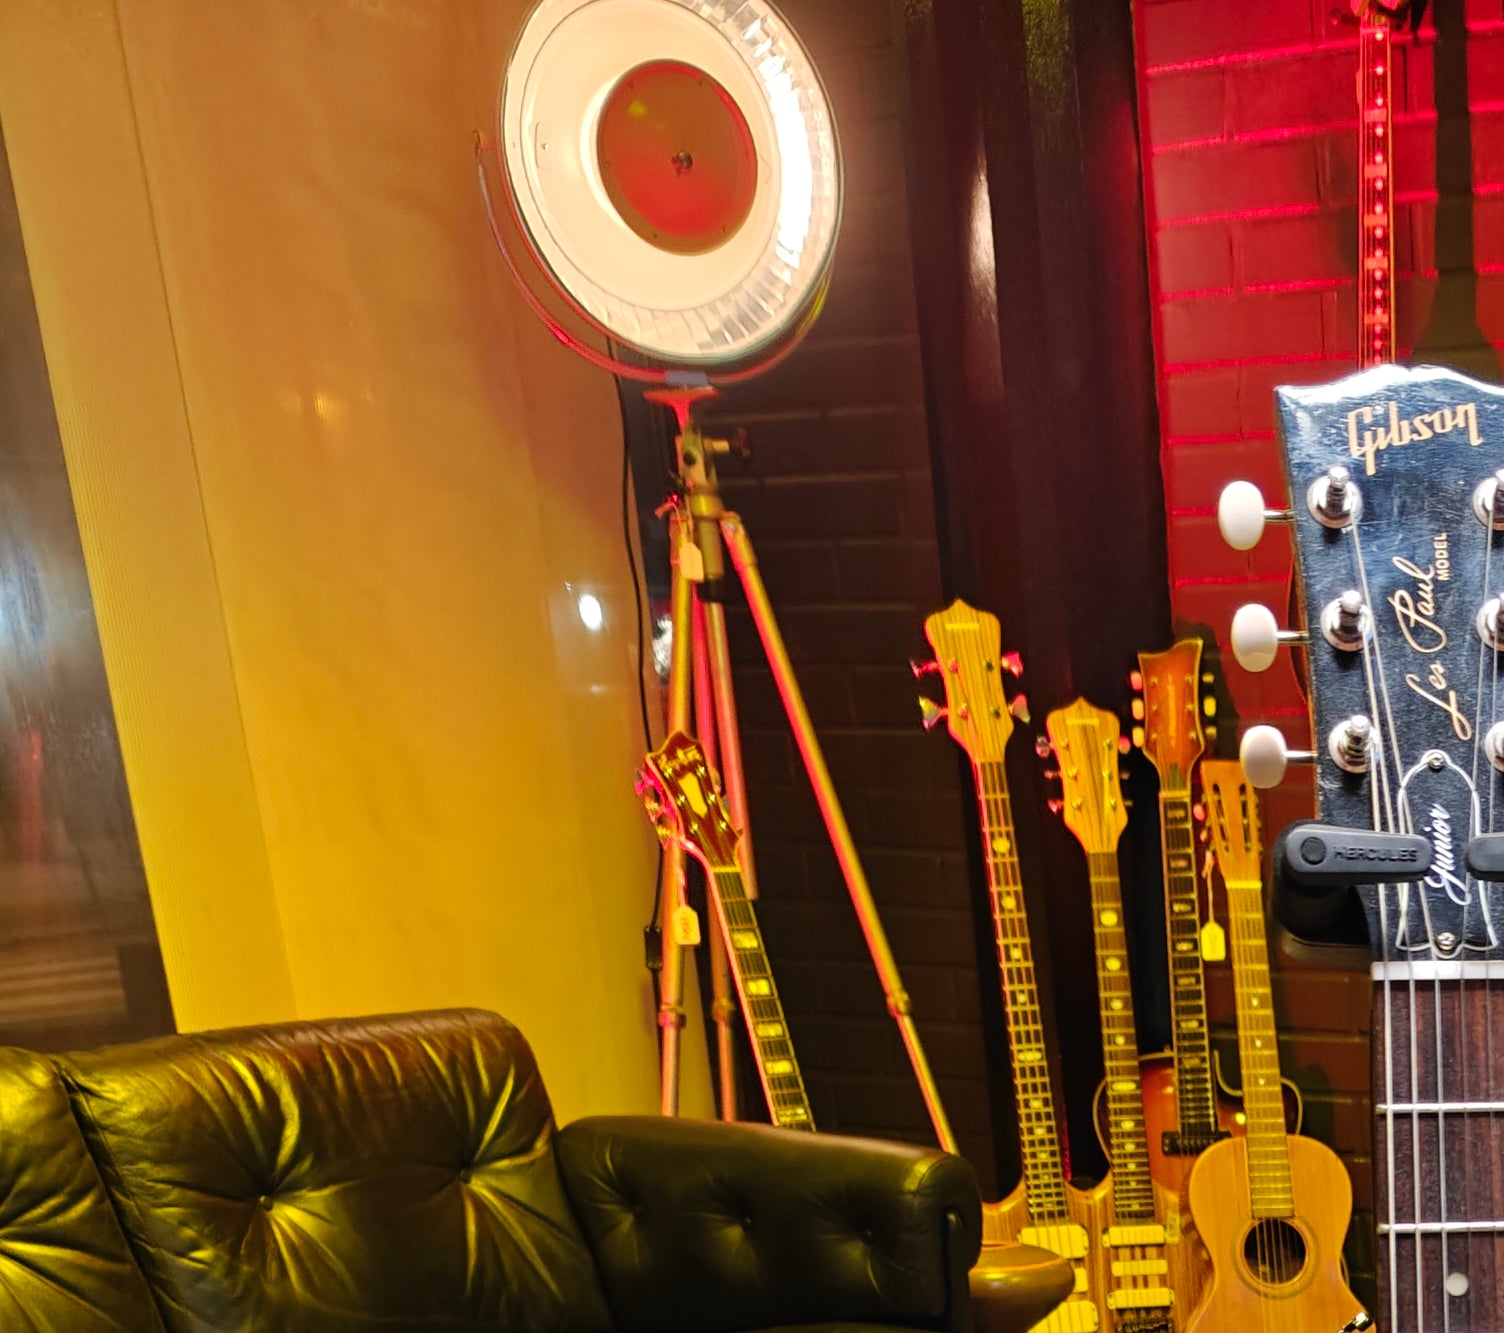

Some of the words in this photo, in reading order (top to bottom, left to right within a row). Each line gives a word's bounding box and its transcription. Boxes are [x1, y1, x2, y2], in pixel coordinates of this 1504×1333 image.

[1347, 401, 1484, 476] Gibson
[1434, 532, 1450, 581] MODEL
[1387, 556, 1448, 653] Paul
[1405, 660, 1472, 741] Les
[1333, 847, 1418, 862] HERCULES
[1423, 803, 1472, 906] Junior
